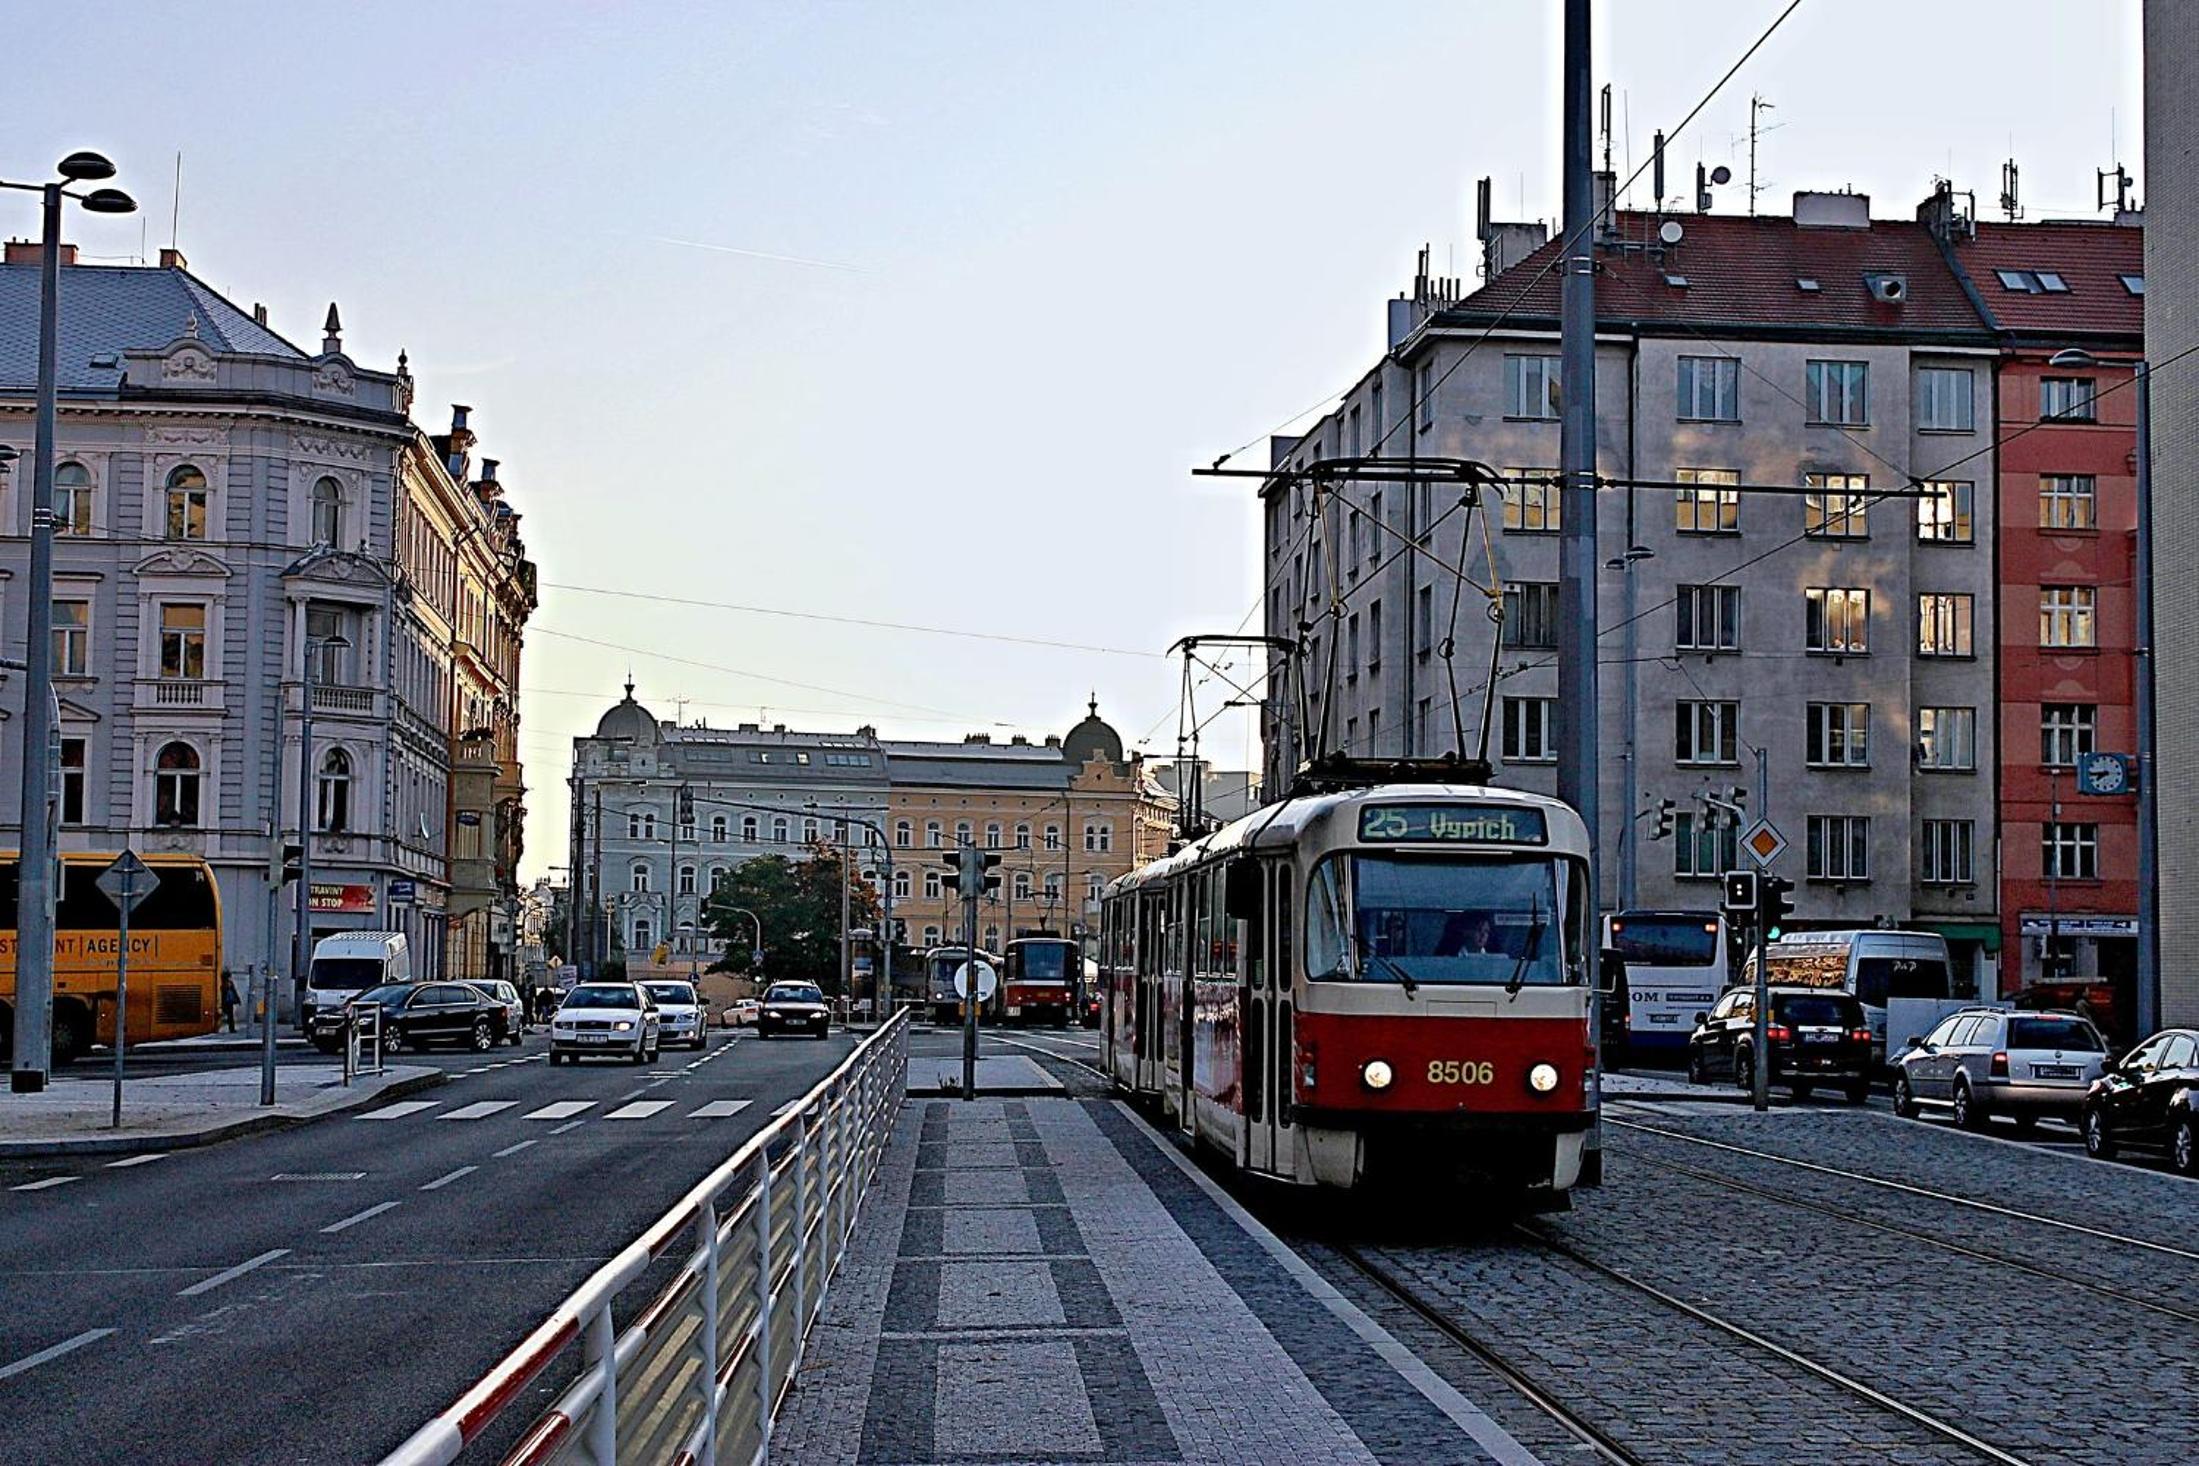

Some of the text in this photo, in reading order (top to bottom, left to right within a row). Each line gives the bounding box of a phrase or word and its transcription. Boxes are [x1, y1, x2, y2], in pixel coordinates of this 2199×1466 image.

[1364, 807, 1516, 841] 25 Vypich
[321, 897, 344, 908] STOP
[87, 938, 151, 954] AGECY
[1427, 1060, 1494, 1085] 8506
